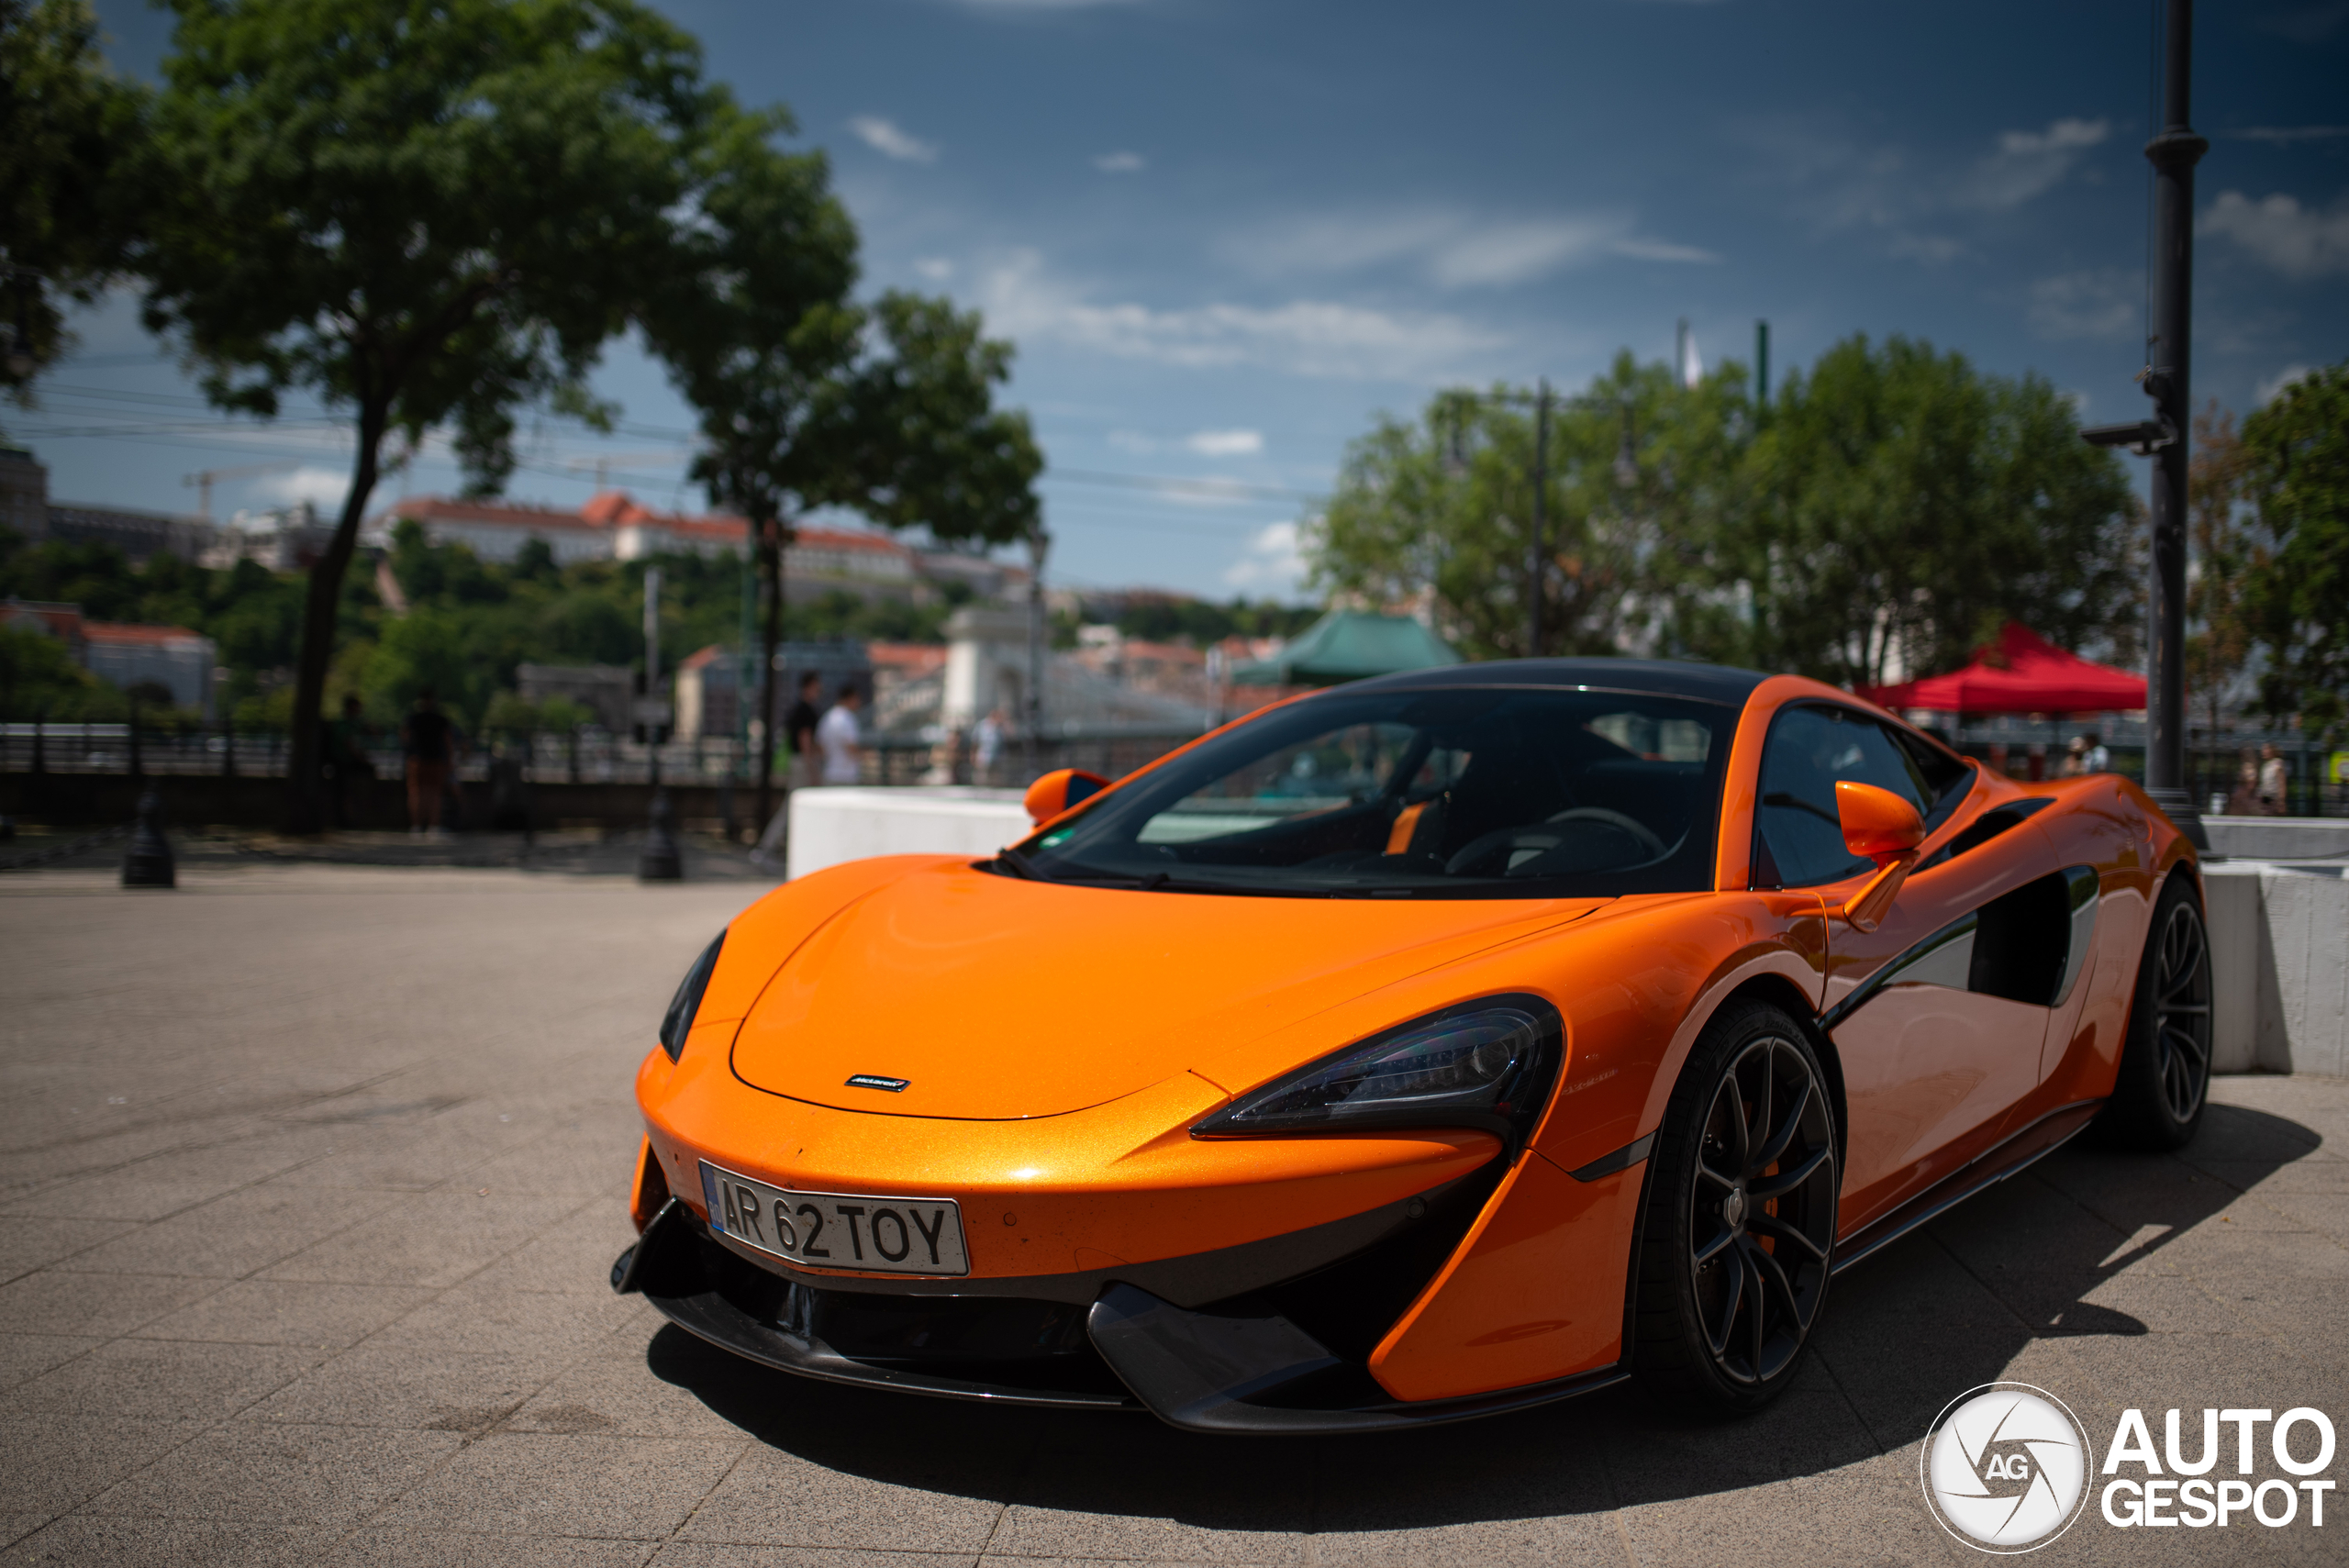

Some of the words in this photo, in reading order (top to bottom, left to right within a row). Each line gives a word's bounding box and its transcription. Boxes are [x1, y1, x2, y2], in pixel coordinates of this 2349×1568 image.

[851, 1077, 898, 1087] McLaren
[707, 1200, 722, 1223] RO
[722, 1178, 764, 1242] AR
[774, 1198, 830, 1258] 62
[837, 1206, 944, 1265] TOY
